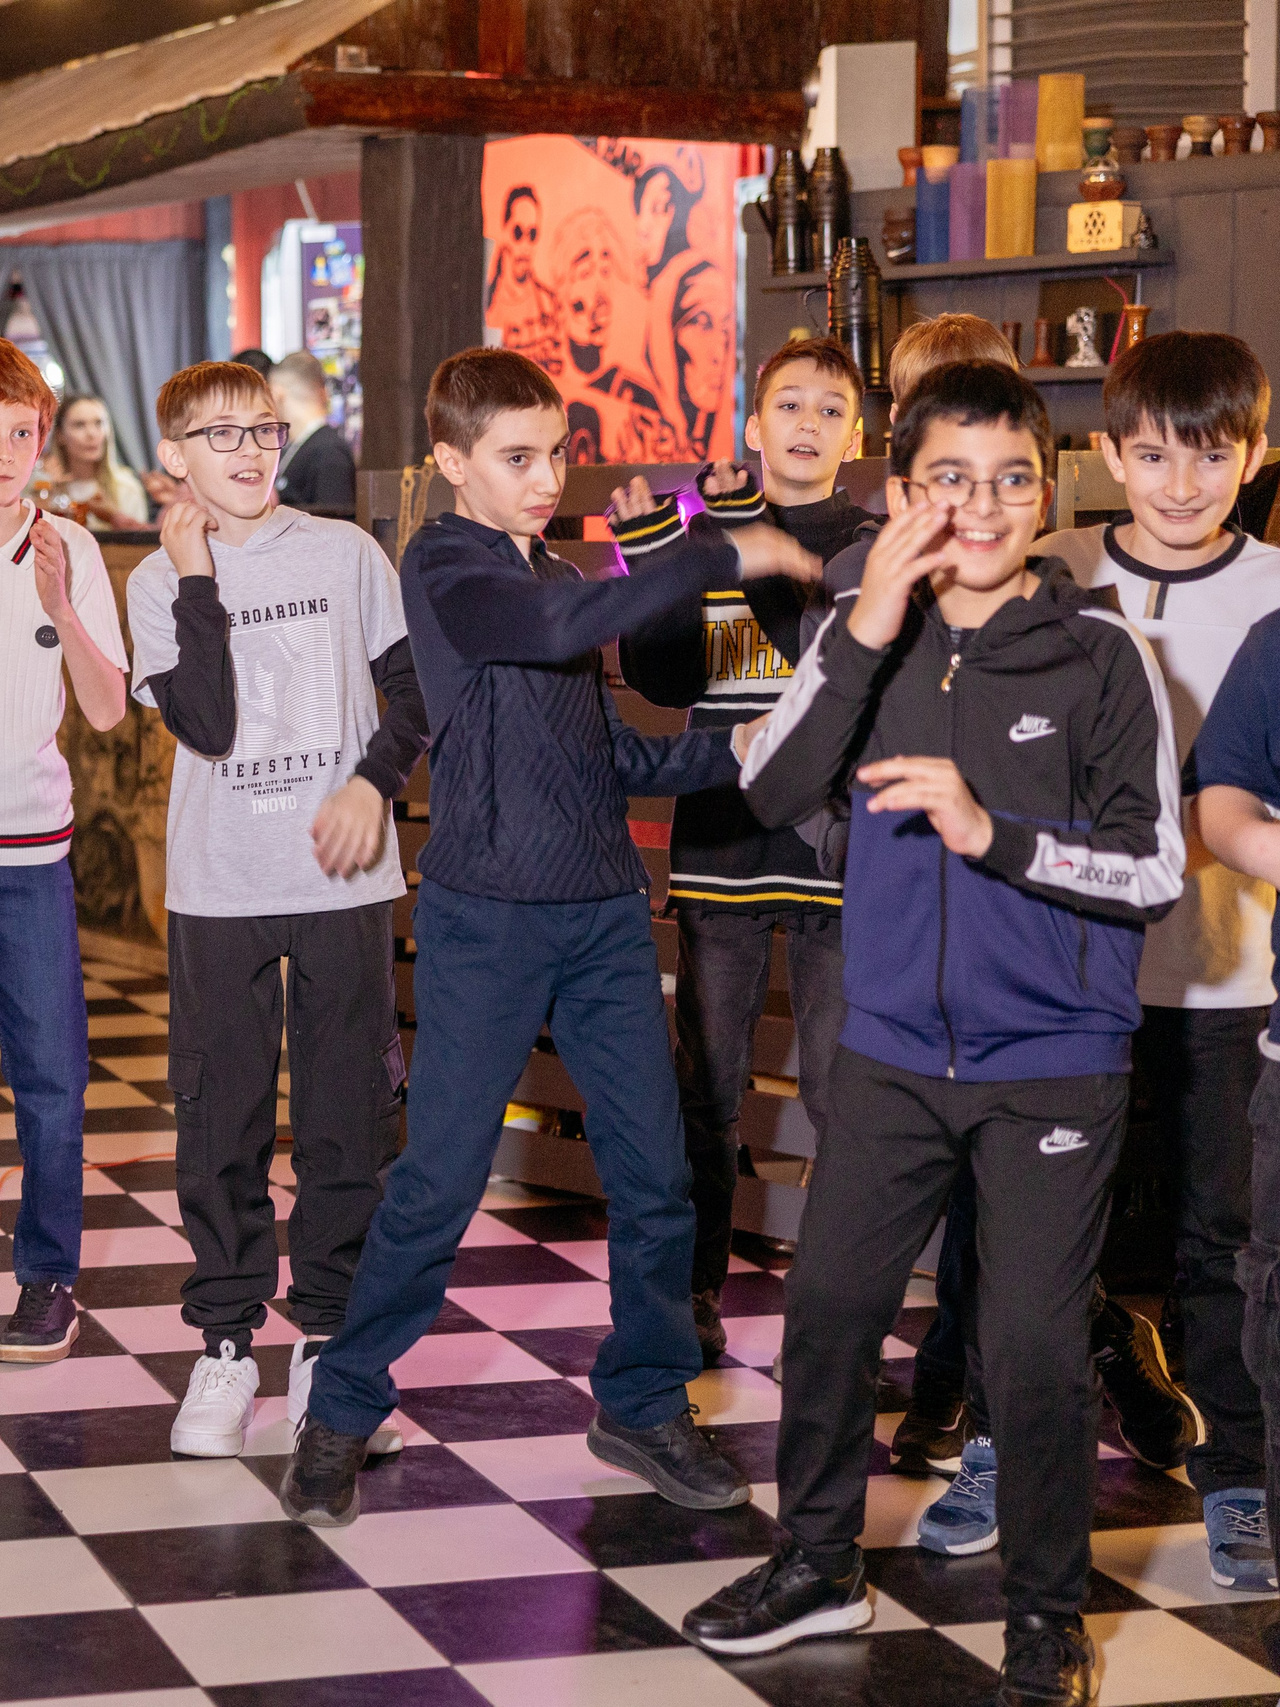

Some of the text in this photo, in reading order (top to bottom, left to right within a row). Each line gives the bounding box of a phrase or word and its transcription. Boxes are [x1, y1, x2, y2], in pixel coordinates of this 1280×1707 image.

[247, 781, 263, 789] YORK
[253, 785, 292, 796] SKATE PARK
[251, 794, 298, 815] INOVO
[1106, 870, 1136, 887] JUST
